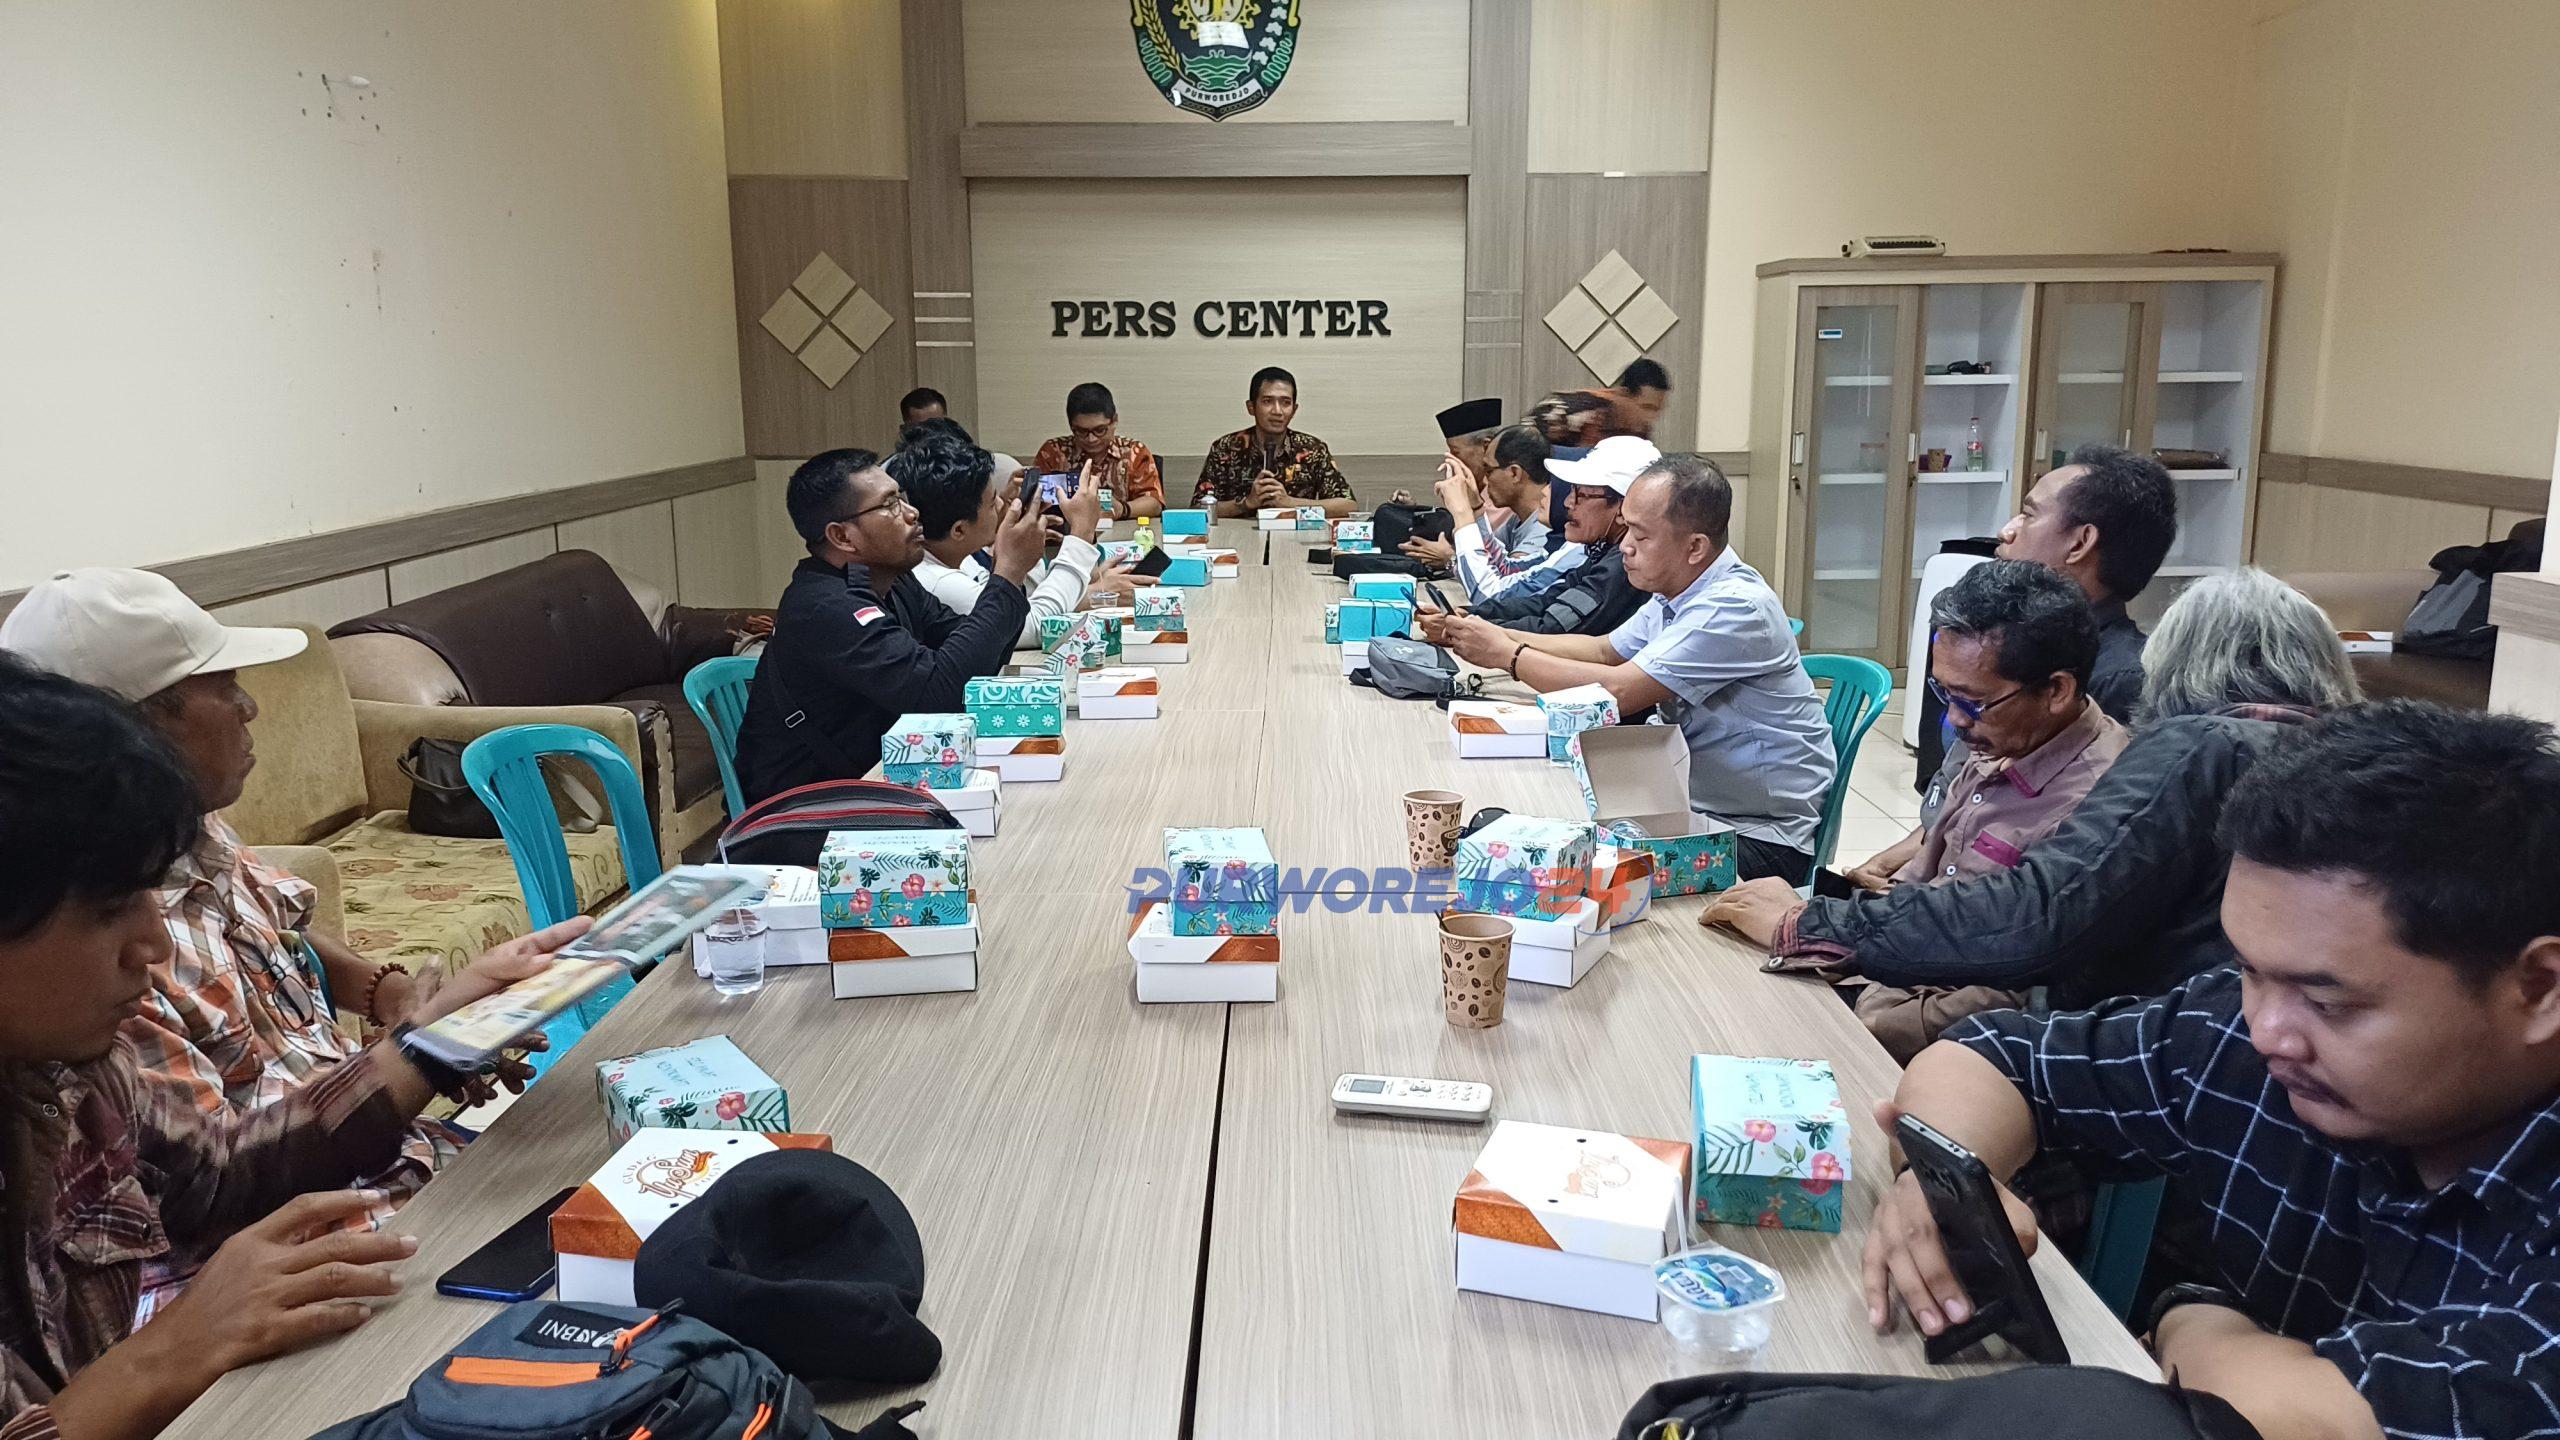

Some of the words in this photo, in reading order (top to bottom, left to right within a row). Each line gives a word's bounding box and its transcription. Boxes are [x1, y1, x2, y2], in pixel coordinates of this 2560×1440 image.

[1185, 87, 1249, 101] PURWOREDJO
[1051, 300, 1177, 337] PERS
[1193, 300, 1391, 337] CENTER
[537, 1319, 581, 1342] BNI
